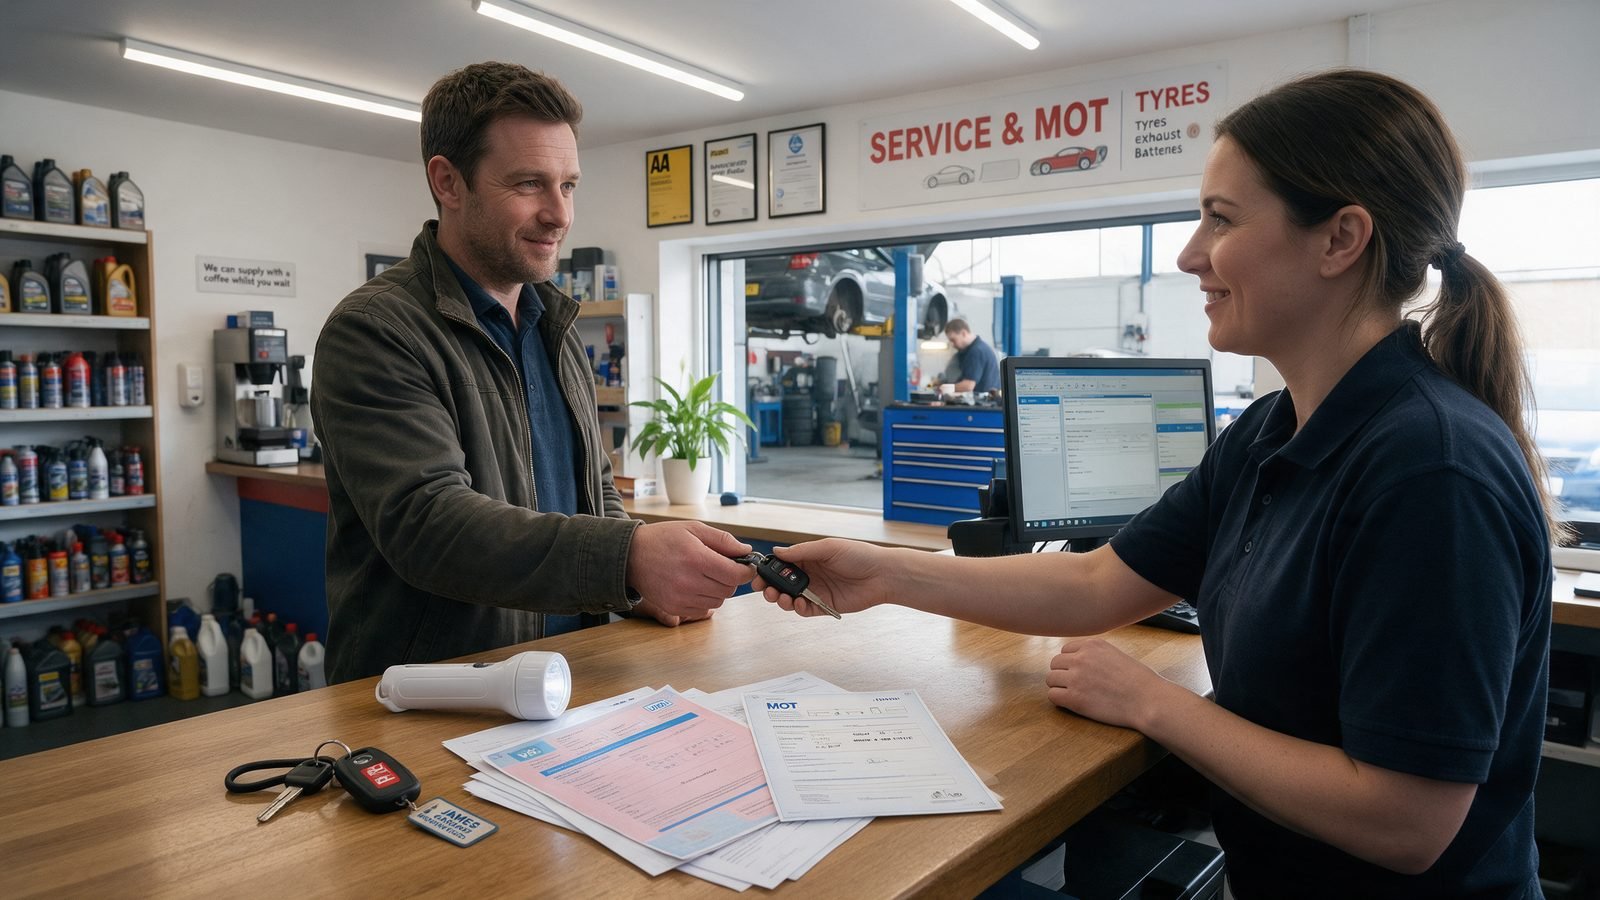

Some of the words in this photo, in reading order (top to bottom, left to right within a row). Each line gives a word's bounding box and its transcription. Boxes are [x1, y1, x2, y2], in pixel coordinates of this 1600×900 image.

[1135, 81, 1210, 112] TYRES
[870, 115, 991, 164] SERVICE
[1002, 112, 1024, 145] &
[1035, 97, 1109, 141] MOT
[1135, 118, 1167, 131] Tyres
[1135, 129, 1181, 144] exhaust
[650, 153, 670, 174] AA
[203, 263, 218, 272] We
[221, 265, 235, 273] can
[238, 266, 264, 277] supply
[266, 268, 283, 276] with
[203, 274, 229, 283] coffee
[231, 276, 255, 285] whilst
[257, 279, 271, 288] you
[273, 279, 290, 287] wait
[766, 702, 798, 710] MOT
[441, 809, 481, 829] JAMES
